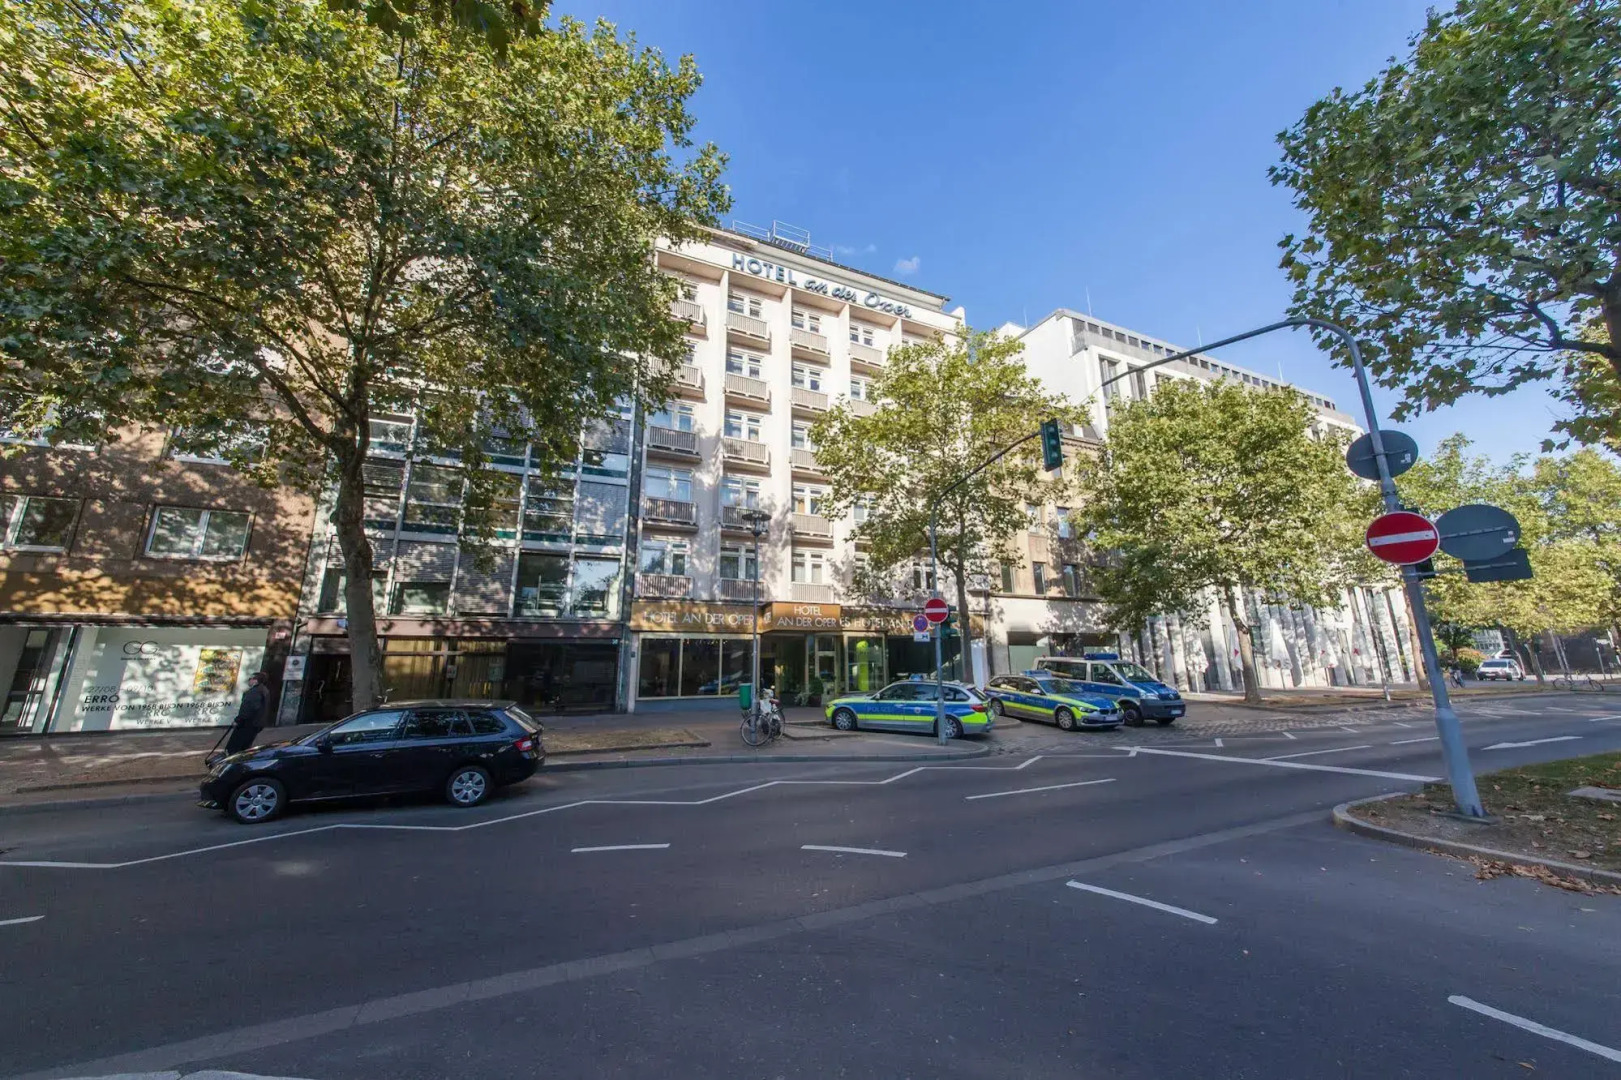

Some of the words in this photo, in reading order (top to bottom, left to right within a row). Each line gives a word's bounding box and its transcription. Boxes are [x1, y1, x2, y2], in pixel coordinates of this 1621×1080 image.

[732, 253, 797, 287] HOTEL
[803, 279, 828, 295] an
[831, 285, 857, 304] der
[864, 291, 912, 319] Oper
[794, 605, 822, 616] HOTEL
[643, 611, 678, 624] HOTEL
[682, 611, 701, 624] AN
[705, 613, 725, 625] DER
[728, 613, 755, 626] OPER
[777, 617, 794, 627] AN
[796, 617, 812, 627] DER
[815, 617, 837, 627] OPER
[854, 618, 887, 629] HOTEL
